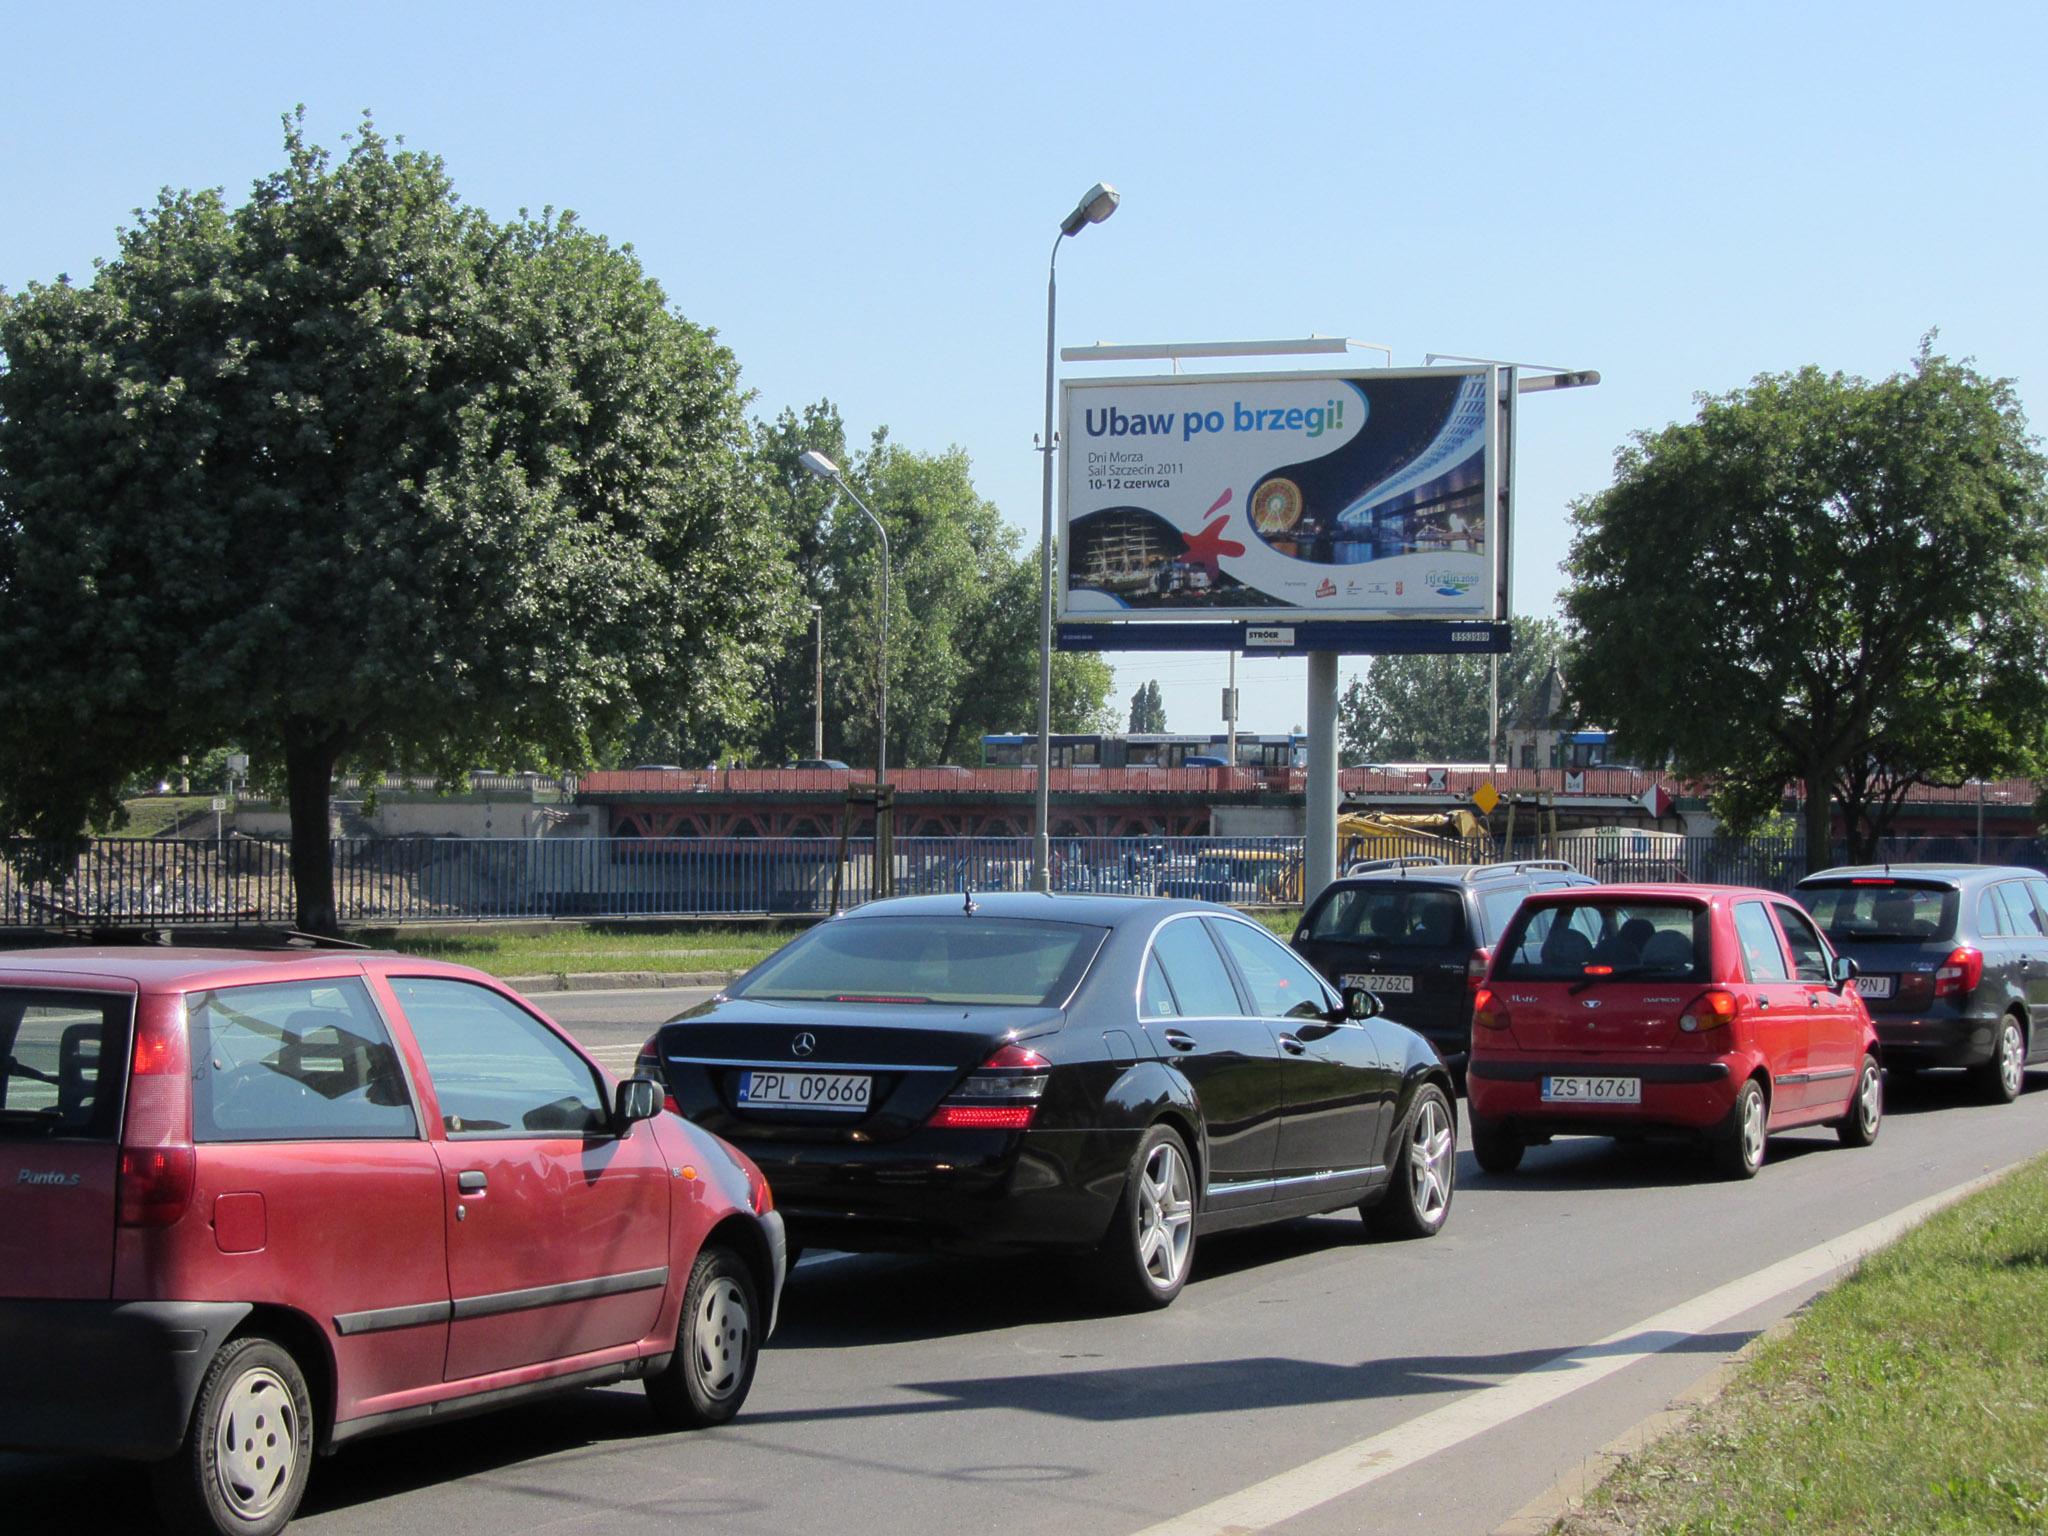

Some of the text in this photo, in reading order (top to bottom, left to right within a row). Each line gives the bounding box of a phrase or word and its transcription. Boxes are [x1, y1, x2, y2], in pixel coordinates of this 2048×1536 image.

[1086, 399, 1344, 442] Ubaw po brzegi!
[1088, 451, 1144, 463] Dni Morza
[1088, 463, 1184, 477] Sail Szczecin 2011
[1088, 478, 1170, 490] 10-12 czerwca
[1248, 630, 1279, 639] STRÖER
[1347, 975, 1413, 992] ZS 2762C
[750, 1074, 869, 1102] ZPL 09666
[1553, 1078, 1636, 1097] ZS 1676J
[16, 1168, 66, 1185] Punto
